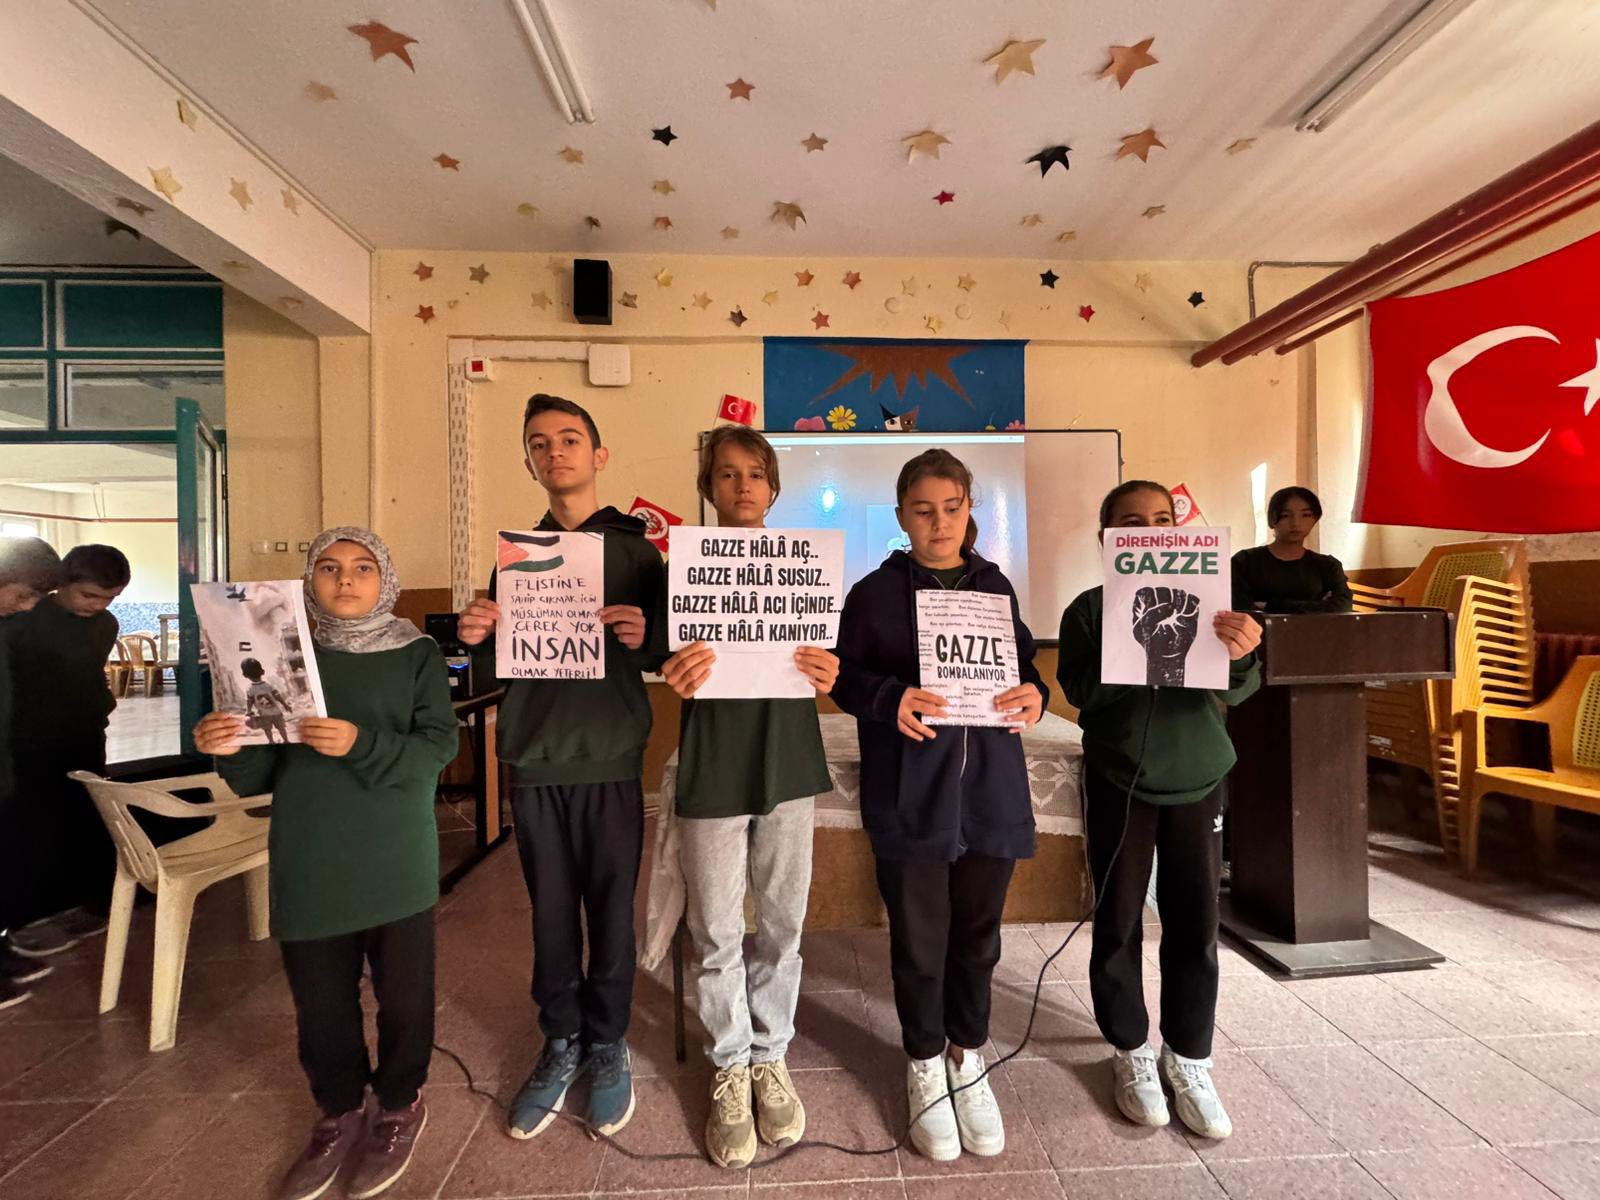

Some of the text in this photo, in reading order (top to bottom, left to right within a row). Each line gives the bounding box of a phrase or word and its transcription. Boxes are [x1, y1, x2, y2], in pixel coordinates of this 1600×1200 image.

[701, 535, 819, 564] GAZZE HÂLÂ AÇ..
[1116, 534, 1219, 549] DİRENİŞİN ADI
[687, 563, 830, 587] GAZZE HÂLÂ SUSUZ..
[1114, 552, 1219, 575] GAZZE
[672, 595, 717, 614] GAZZE
[721, 591, 758, 614] HÂLÂ
[763, 596, 787, 614] ACI
[679, 619, 833, 642] GAZZE HÂLÂ KANIYOR..
[512, 630, 600, 665] İNSAN
[935, 634, 1006, 666] GAZZE
[511, 667, 549, 678] OLMAK
[937, 666, 1006, 681] BOMBALANIYOR
